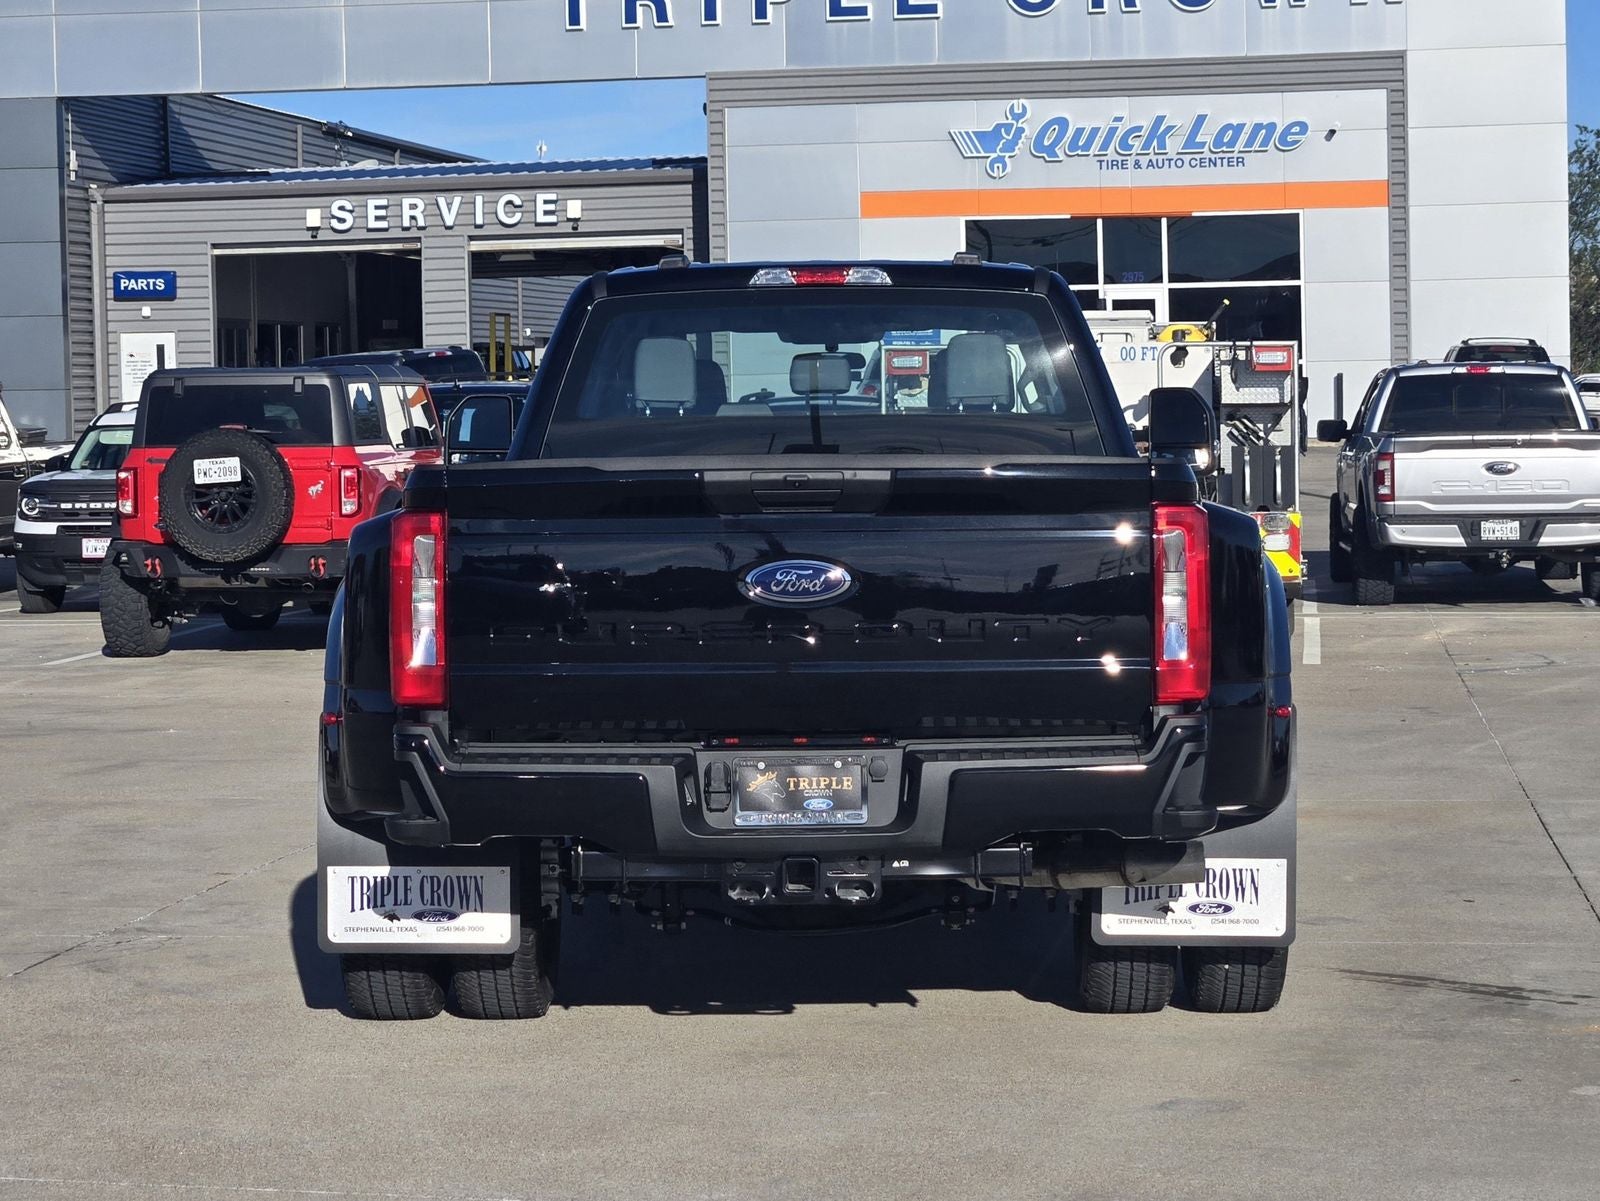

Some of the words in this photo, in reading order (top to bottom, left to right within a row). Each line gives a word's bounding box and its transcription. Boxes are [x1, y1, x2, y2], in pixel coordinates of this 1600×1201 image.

[1031, 111, 1183, 162] Quick
[1176, 111, 1310, 154] Lane
[1097, 159, 1130, 171] TIRE
[1133, 158, 1143, 170] &
[1146, 157, 1185, 170] AUTO
[1188, 156, 1246, 169] CENTER
[329, 192, 560, 232] SERVICE
[119, 276, 166, 292] PARTS
[1122, 271, 1145, 282] 2975
[1141, 346, 1158, 361] FT
[1432, 478, 1571, 494] F-150
[770, 568, 826, 592] Ford
[786, 776, 853, 791] TRIPLE
[803, 789, 833, 797] CROWN
[807, 799, 829, 810] Ford
[347, 875, 412, 913] TRIPLE
[419, 874, 484, 913] CROWN
[1194, 867, 1260, 906] CROWN
[1195, 902, 1225, 914] Ford
[421, 911, 449, 922] Ford
[1117, 918, 1170, 926] STEPHENVILLE,
[436, 925, 452, 933] (254)
